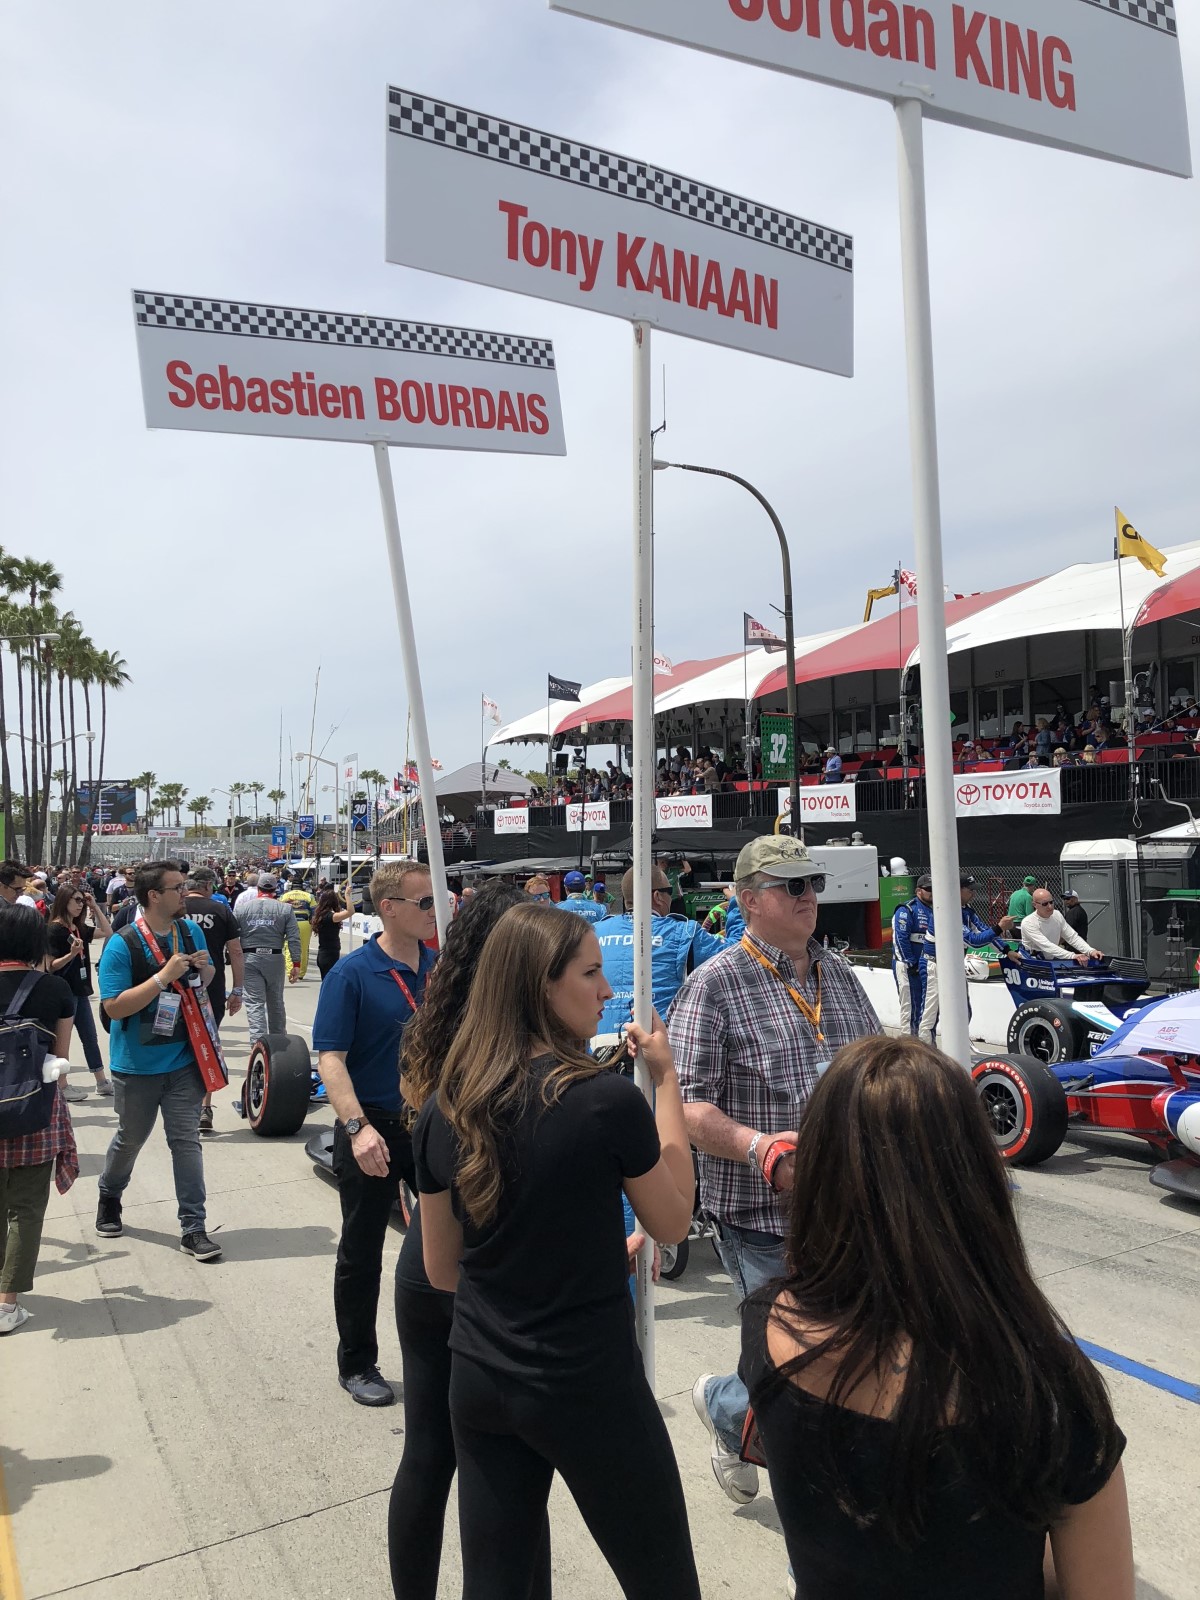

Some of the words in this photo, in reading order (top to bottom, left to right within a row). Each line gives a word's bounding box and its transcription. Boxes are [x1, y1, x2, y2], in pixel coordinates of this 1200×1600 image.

[728, 0, 936, 71] ordan
[952, 4, 1077, 112] KING
[499, 199, 604, 292] Tony
[616, 231, 779, 330] KANAAN
[165, 359, 365, 420] Sebastien
[374, 376, 550, 435] BOURDAIS
[769, 733, 787, 763] 32
[982, 782, 1052, 800] TOYOTA
[354, 803, 366, 814] 30
[673, 804, 708, 817] TOYOTA
[801, 795, 850, 811] TOYOTA
[504, 815, 526, 825] TOYOTA
[246, 918, 276, 926] verizon
[598, 935, 623, 947] NTT
[1003, 968, 1022, 985] 30
[1038, 984, 1056, 992] Rentals
[1008, 1006, 1040, 1044] Firestone
[985, 1061, 1028, 1095] Firestone
